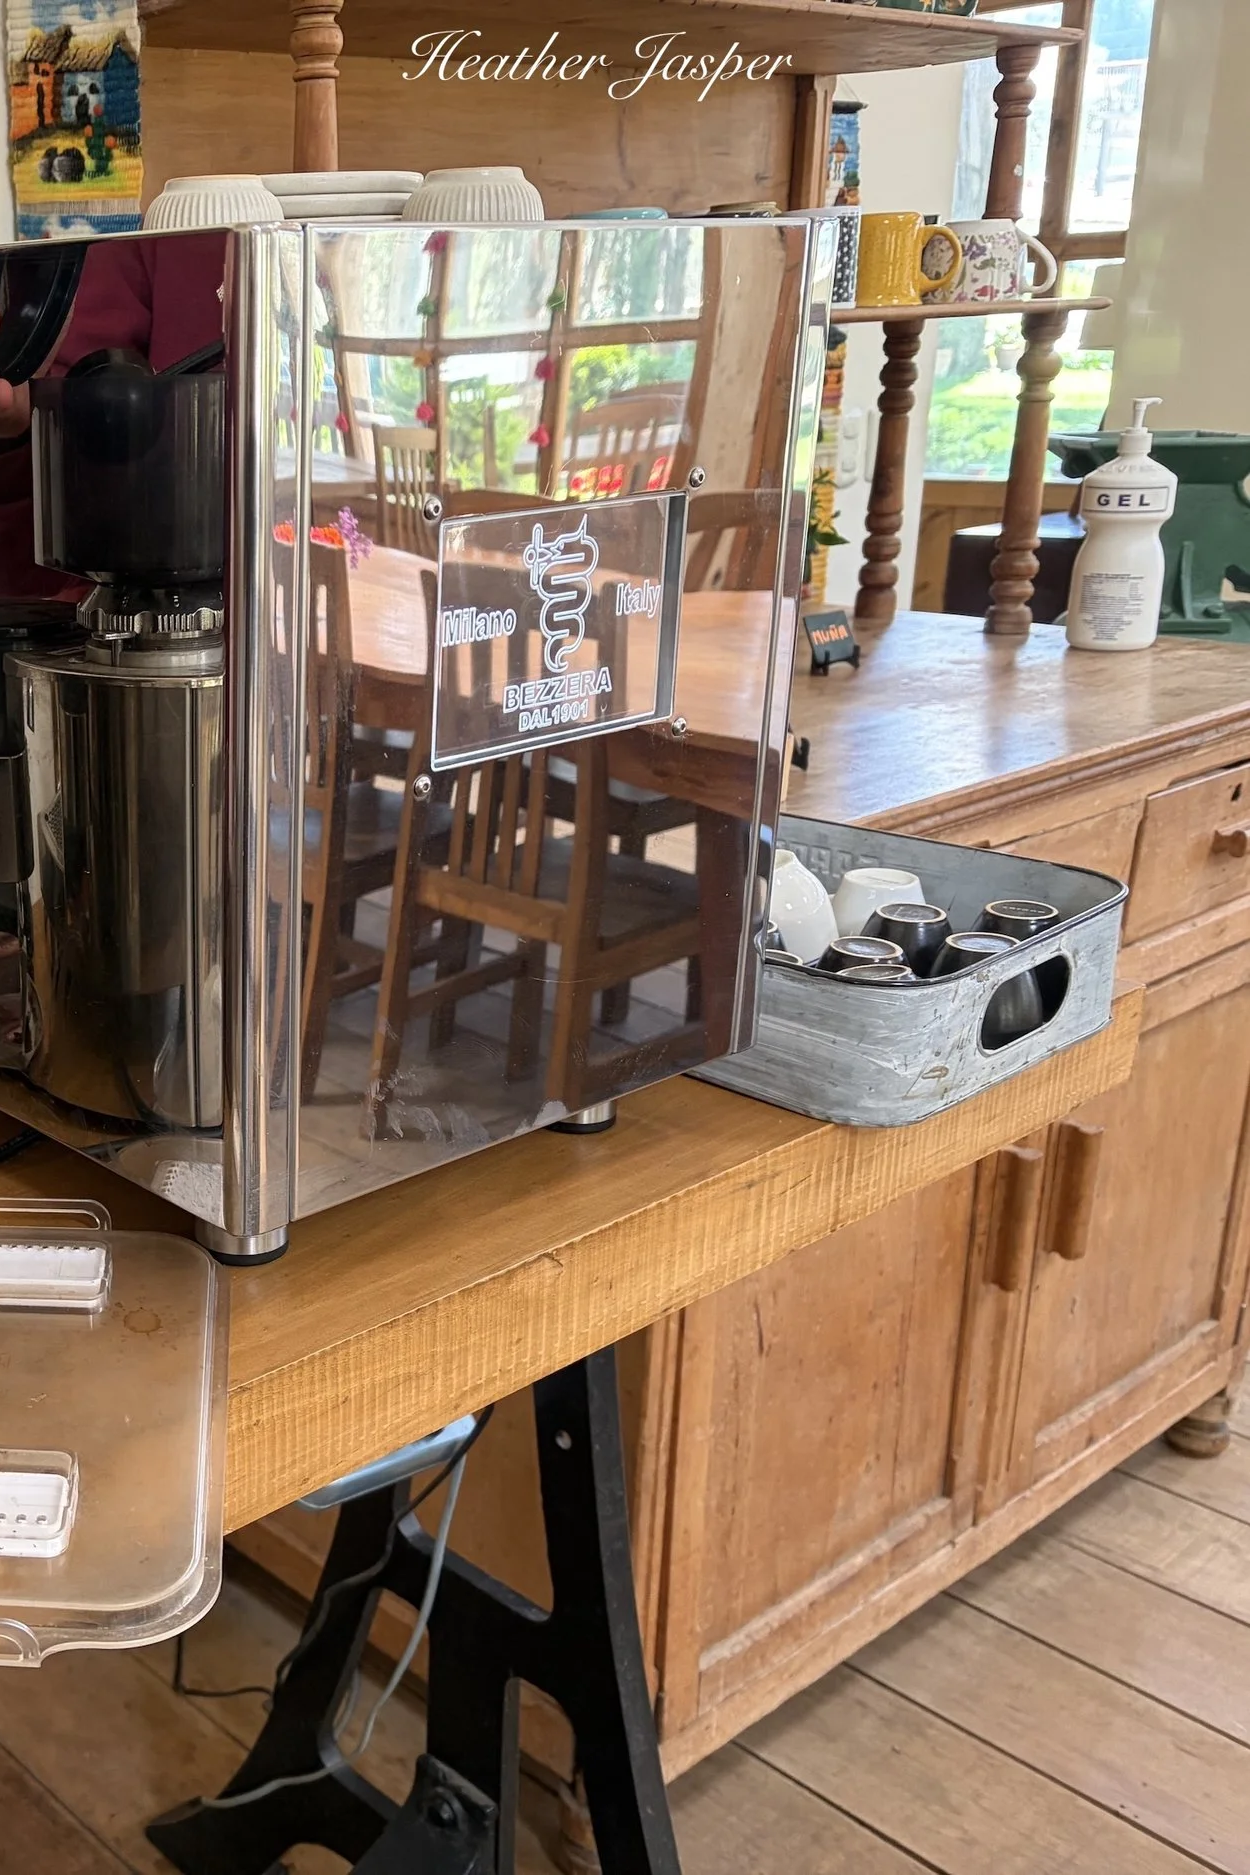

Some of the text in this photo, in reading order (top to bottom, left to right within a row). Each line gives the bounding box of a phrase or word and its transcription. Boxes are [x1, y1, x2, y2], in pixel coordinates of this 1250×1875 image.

[1097, 494, 1150, 507] GEL
[442, 579, 661, 647] Milano Italy
[503, 667, 612, 713] BEZZERA
